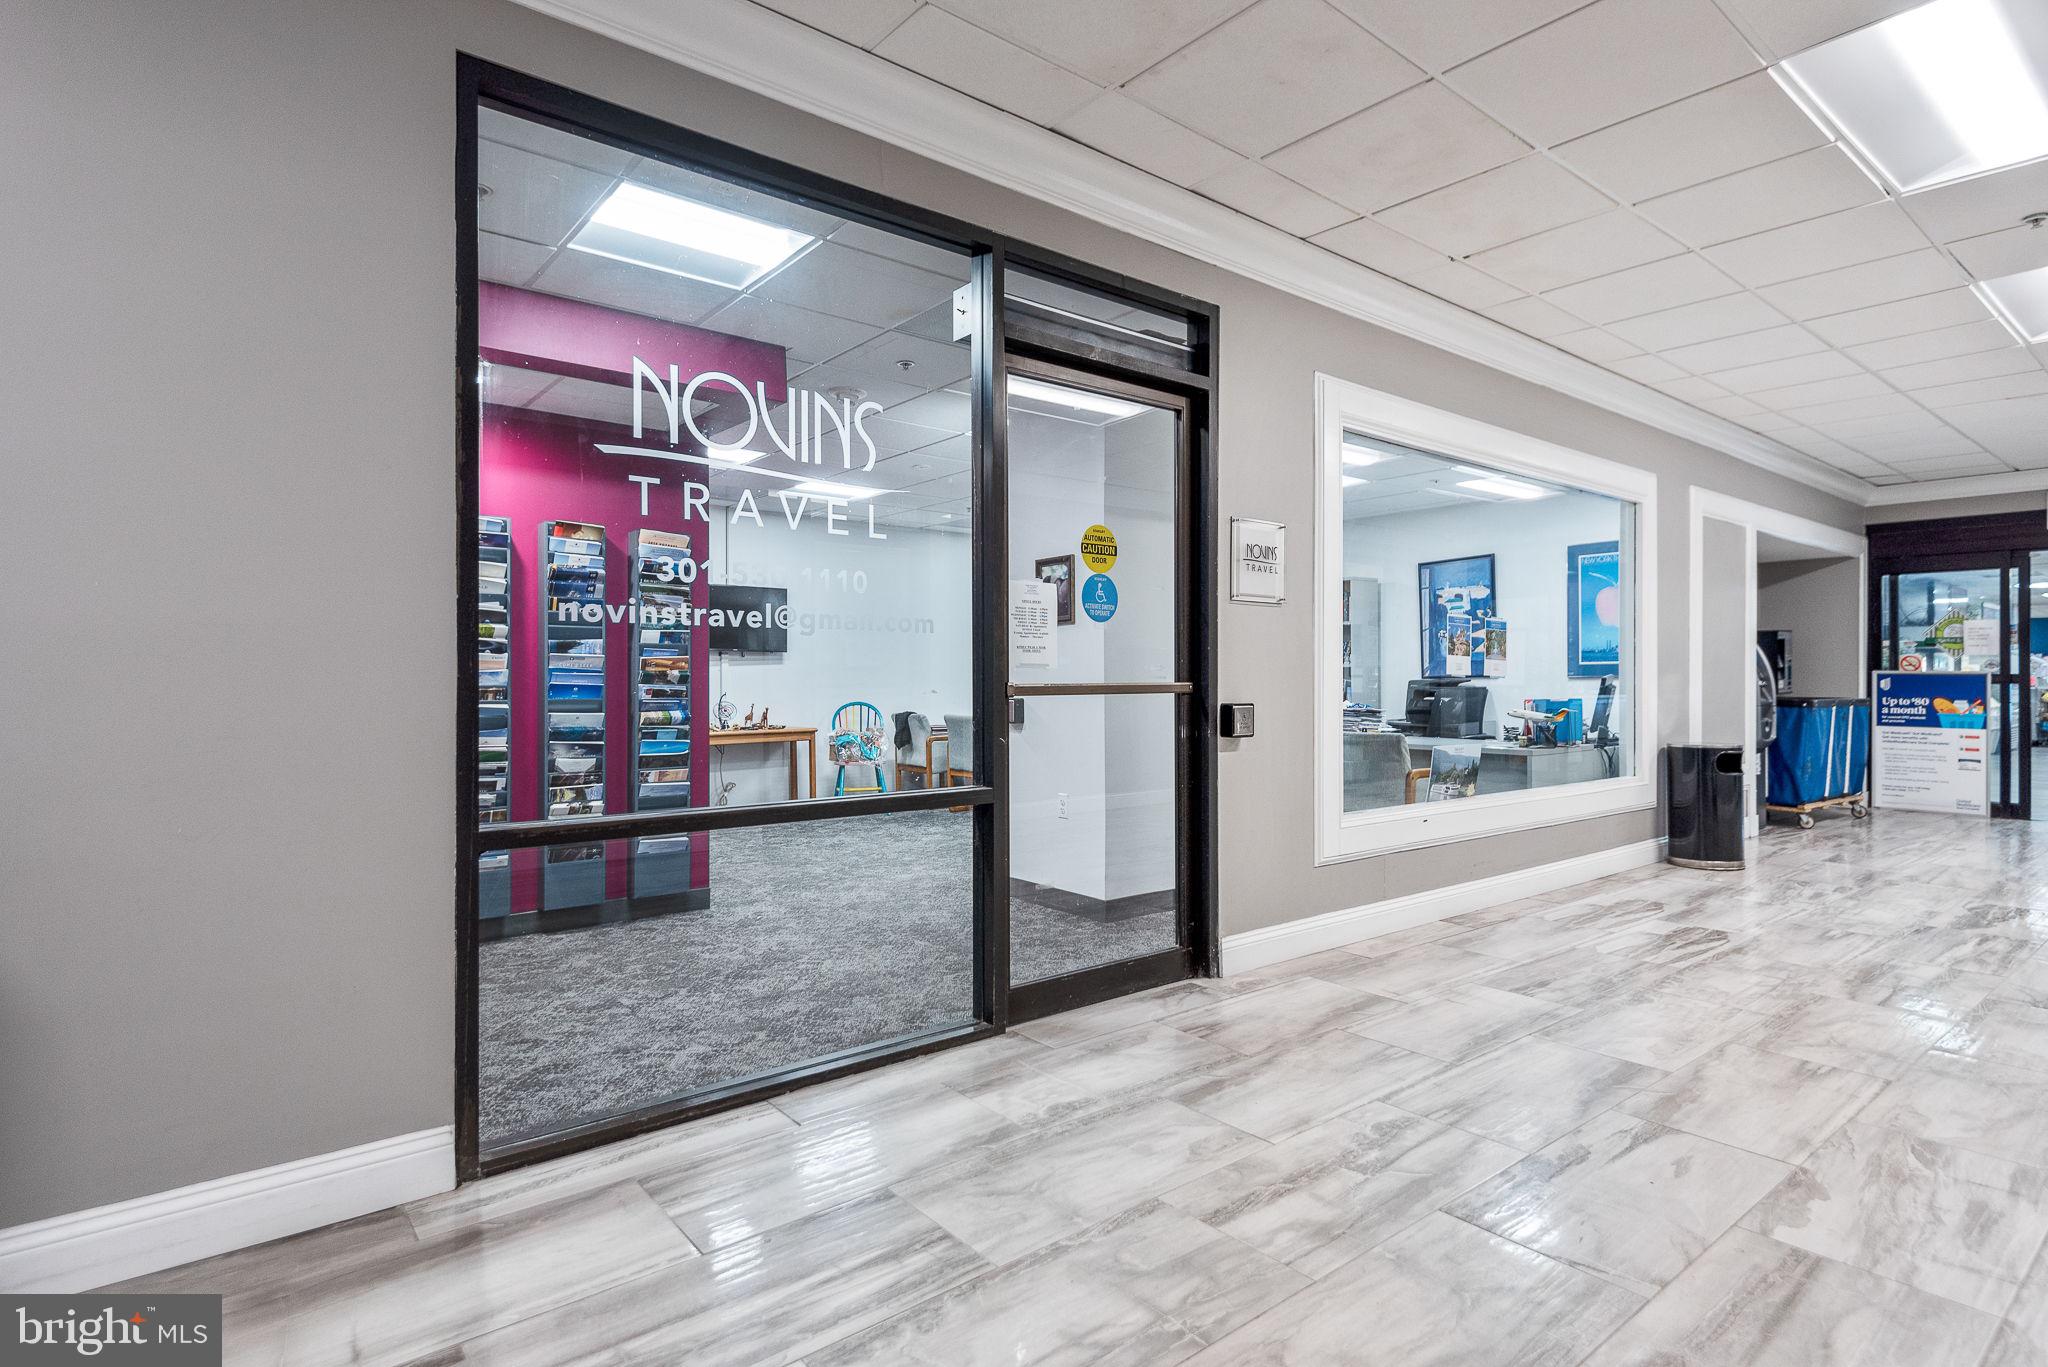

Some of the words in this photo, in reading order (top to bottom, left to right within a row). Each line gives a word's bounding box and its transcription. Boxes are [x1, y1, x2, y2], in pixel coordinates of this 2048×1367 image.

[633, 355, 884, 472] NOVINS
[628, 474, 887, 540] TRAVEL
[1083, 534, 1115, 543] AUTOMATIC
[1082, 543, 1115, 555] CAUTION
[1246, 543, 1278, 561] NOVINS
[1091, 556, 1108, 564] DOOR
[1246, 563, 1279, 575] TRAVEL
[558, 598, 934, 636] novinstravel@gmail.com
[1881, 696, 1898, 707] Up
[1898, 697, 1910, 706] to
[1911, 696, 1930, 706] $80
[1881, 706, 1889, 714] a
[1889, 705, 1927, 715] month
